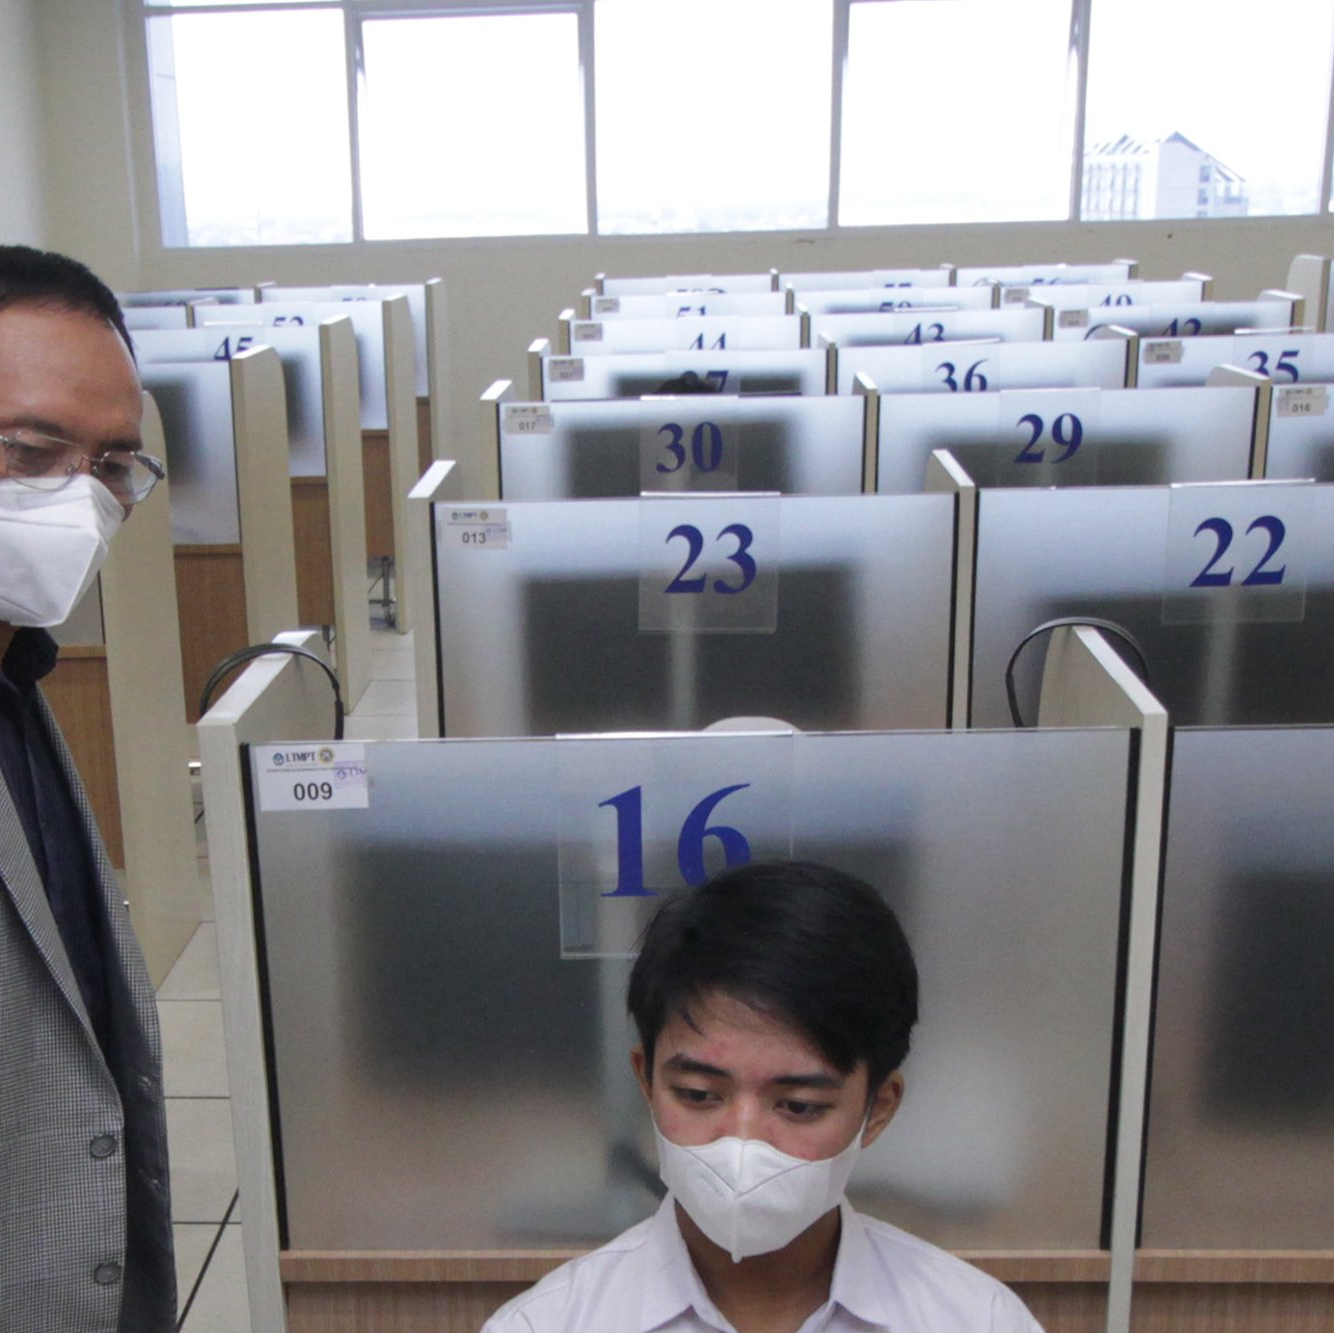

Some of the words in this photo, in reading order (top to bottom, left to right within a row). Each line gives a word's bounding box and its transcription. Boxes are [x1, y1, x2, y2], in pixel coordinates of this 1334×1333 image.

[935, 359, 989, 392] 36
[1247, 351, 1300, 383] 35
[655, 421, 723, 474] 30
[1014, 413, 1084, 464] 29
[462, 532, 486, 544] 013
[664, 523, 757, 594] 23
[1189, 515, 1287, 588] 22
[293, 782, 333, 800] 009
[598, 783, 751, 897] 16
